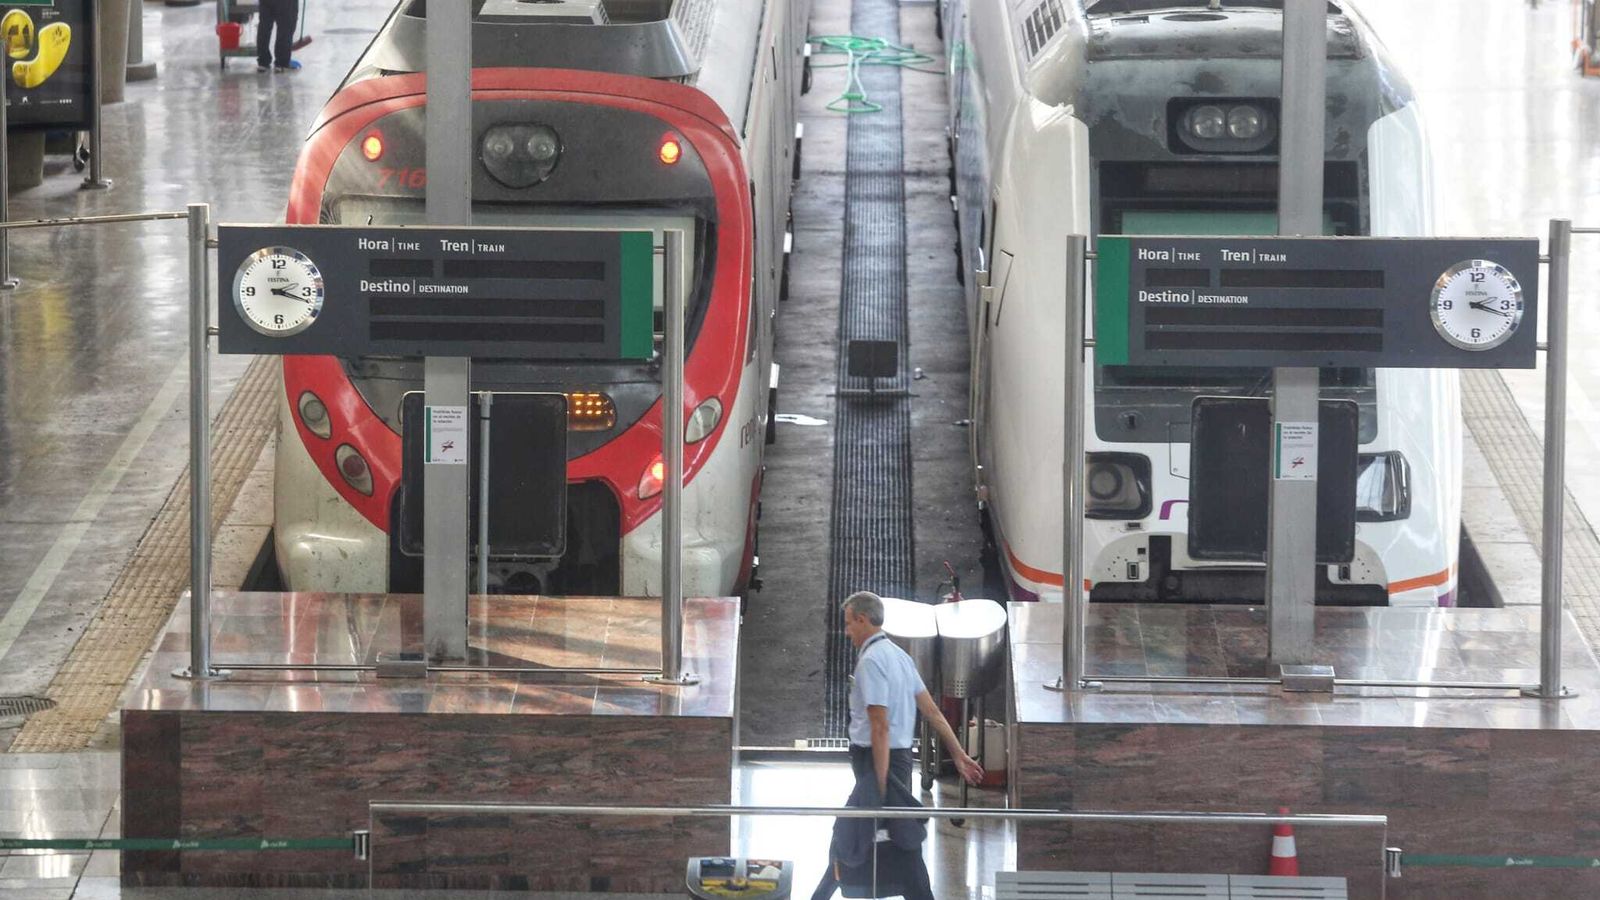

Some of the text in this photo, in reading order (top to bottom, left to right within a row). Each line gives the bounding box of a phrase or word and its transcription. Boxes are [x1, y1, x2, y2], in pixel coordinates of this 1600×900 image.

[358, 238, 505, 253] Hora TIME Tren TRAIN
[1138, 248, 1287, 262] Hora TIME Tren TRAIN
[271, 259, 287, 269] 12
[1469, 272, 1486, 283] 12
[246, 286, 256, 297] 9
[302, 286, 312, 297] 3
[360, 279, 469, 294] Destino DESTINATION
[1139, 290, 1249, 304] Destino DESTINATION
[1442, 300, 1453, 310] 9
[1500, 300, 1510, 310] 3
[274, 314, 284, 325] 6
[1471, 328, 1481, 338] 6
